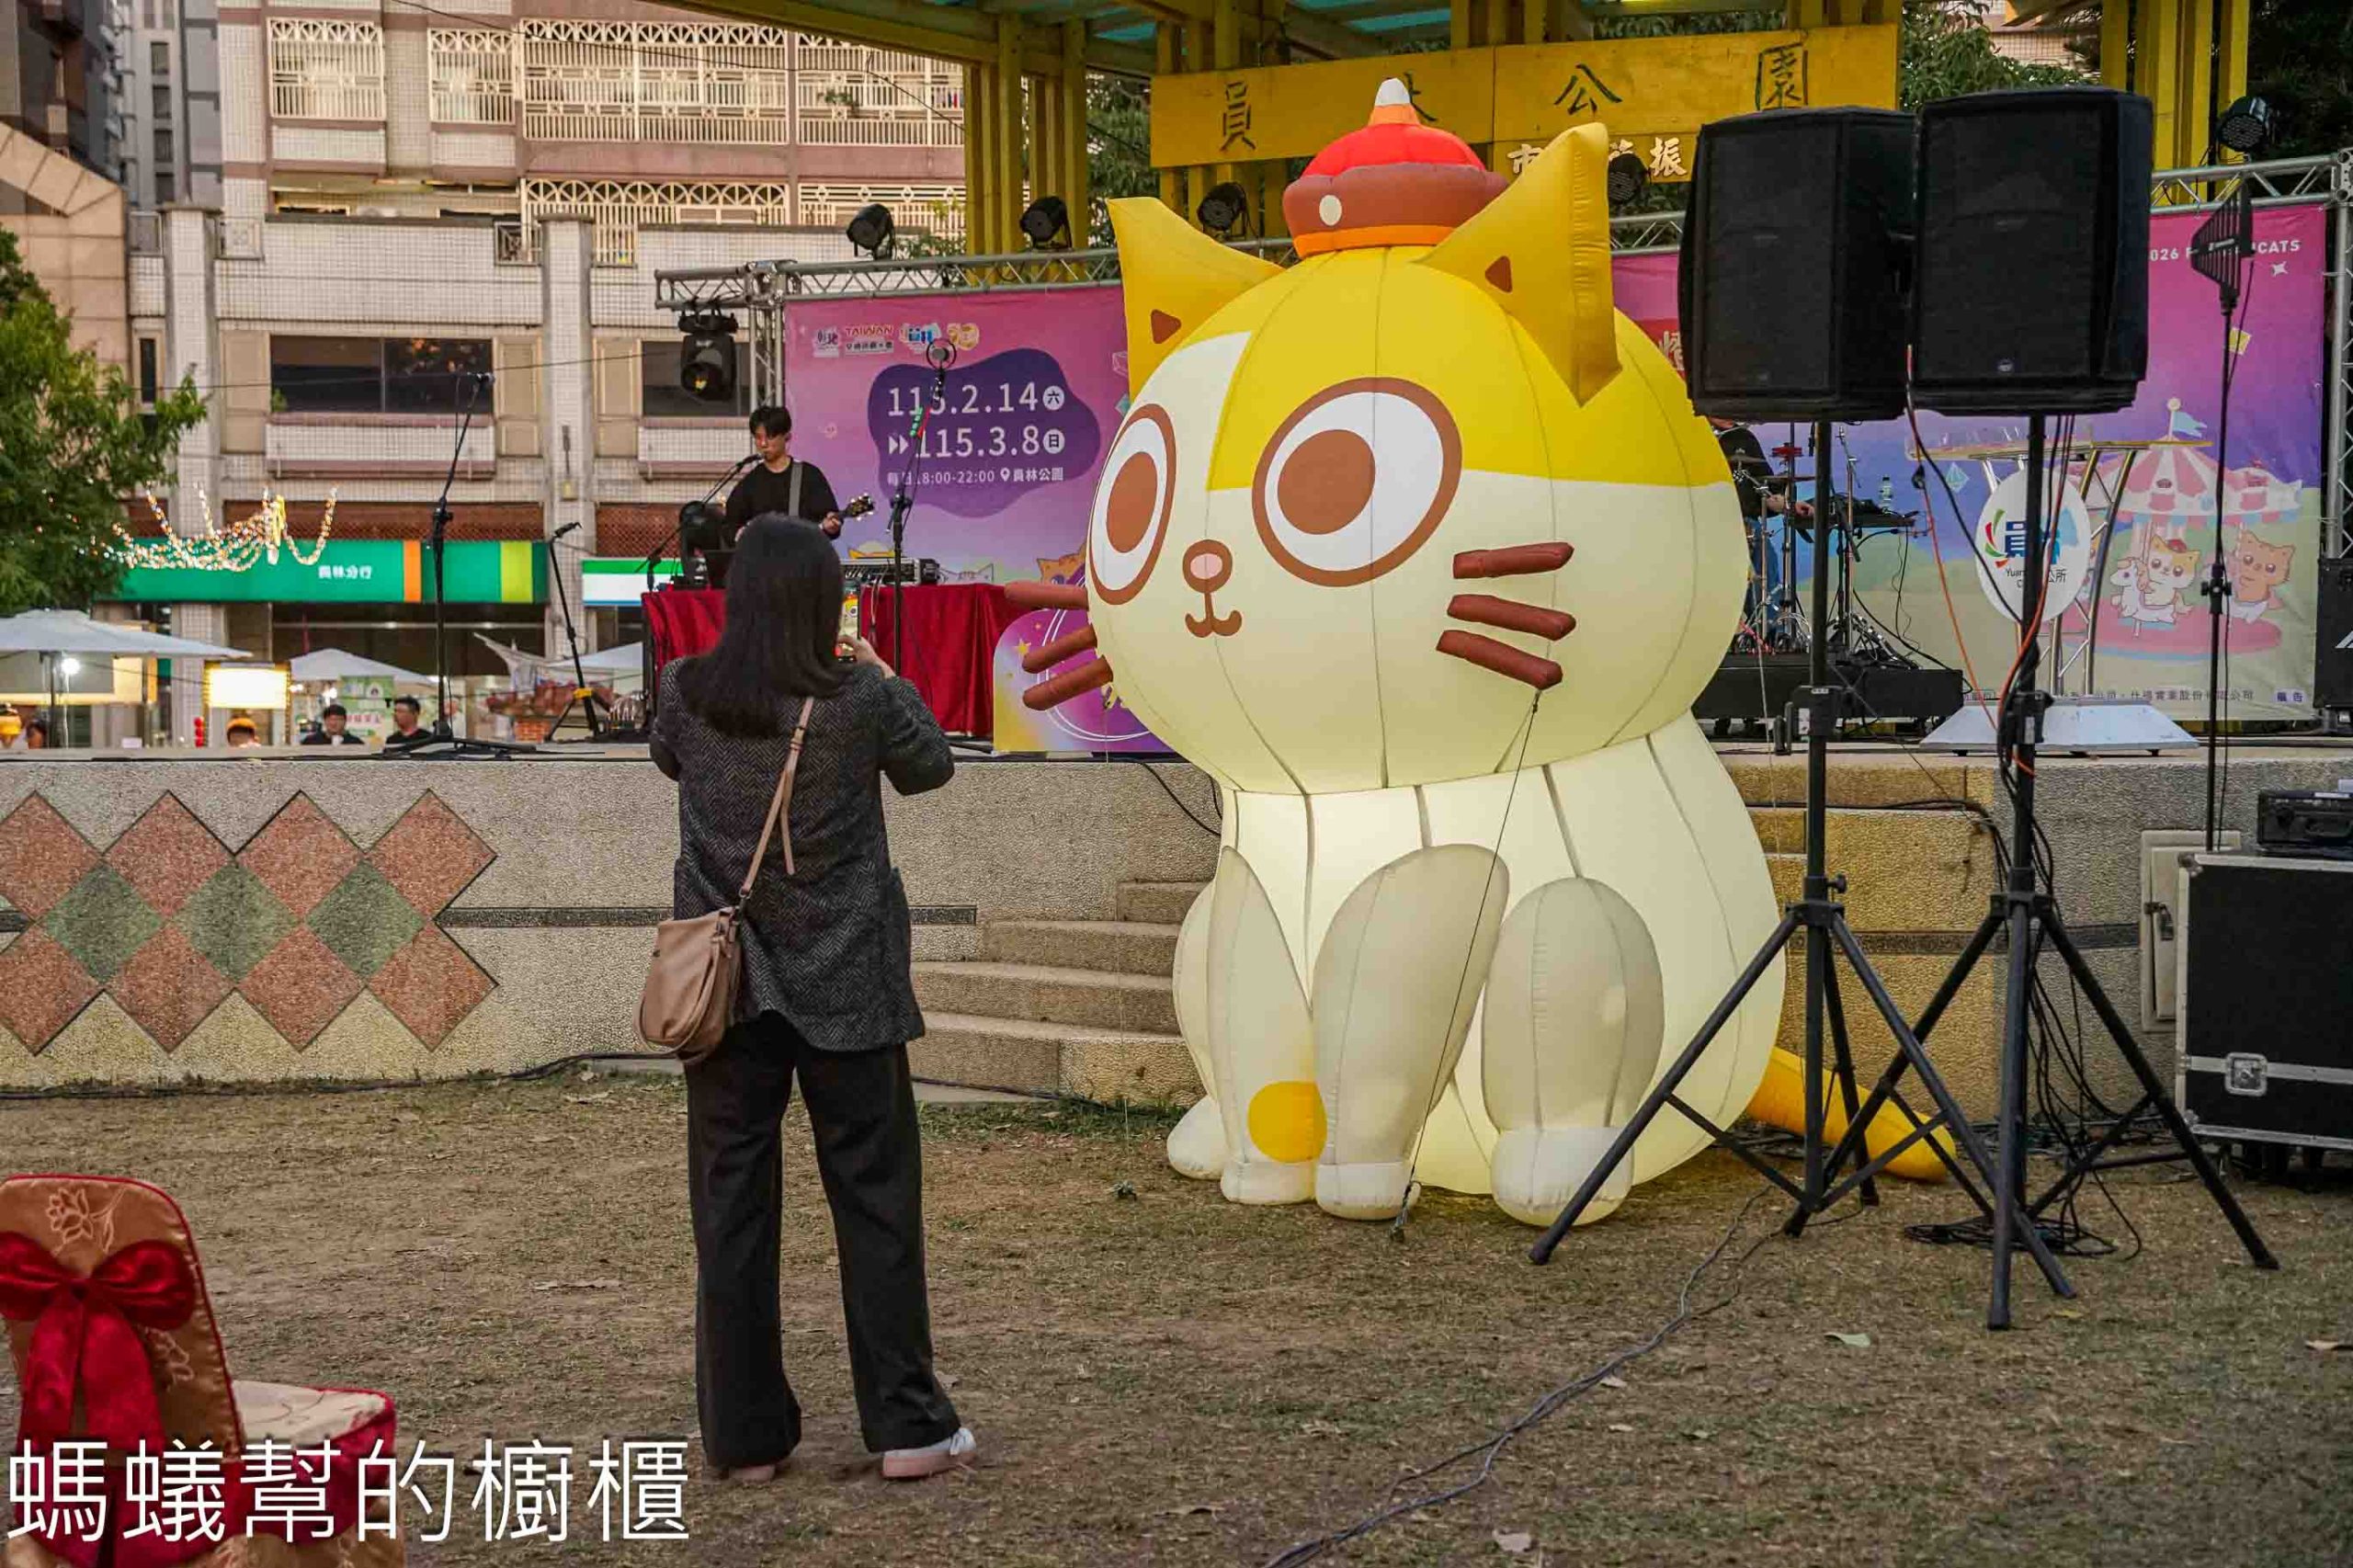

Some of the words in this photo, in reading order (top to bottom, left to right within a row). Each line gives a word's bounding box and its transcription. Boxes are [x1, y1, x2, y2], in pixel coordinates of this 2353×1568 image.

[915, 426, 1040, 458] 115.3.8
[1013, 467, 1064, 483] 員林公園
